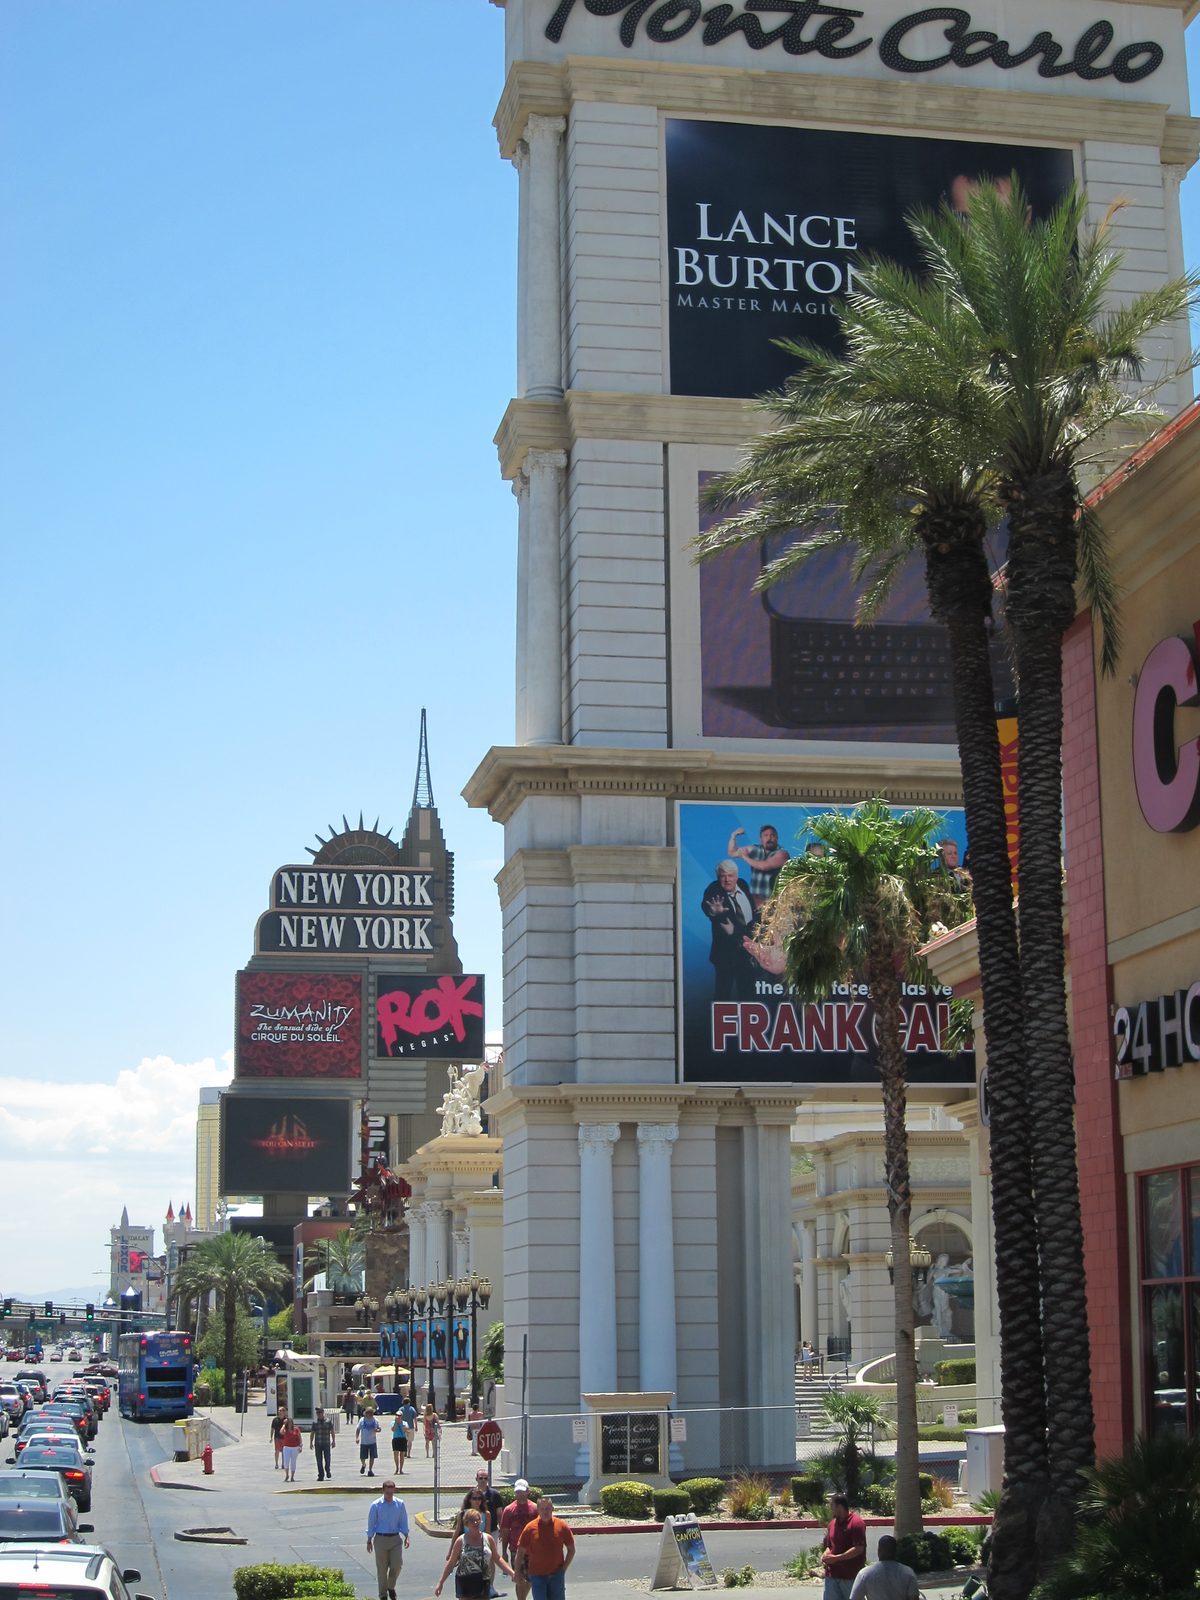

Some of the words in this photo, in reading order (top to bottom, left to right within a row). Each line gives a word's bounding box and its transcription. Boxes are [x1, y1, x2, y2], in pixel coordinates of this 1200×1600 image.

[880, 7, 1164, 84] Carlo
[695, 203, 858, 250] LANCE
[676, 293, 761, 312] MASTER
[279, 871, 347, 905] NEW
[353, 873, 434, 907] YORK
[279, 915, 347, 948] NEW
[353, 917, 434, 950] YORK
[755, 980, 784, 995] the
[902, 982, 927, 996] las
[711, 1001, 868, 1052] FRANK
[250, 1032, 288, 1043] CIRQUE
[290, 1033, 305, 1041] DU
[306, 1033, 341, 1042] SOLEIL
[398, 1034, 449, 1054] VEGAS
[478, 1432, 501, 1449] STOP
[675, 1532, 700, 1541] CANYON
